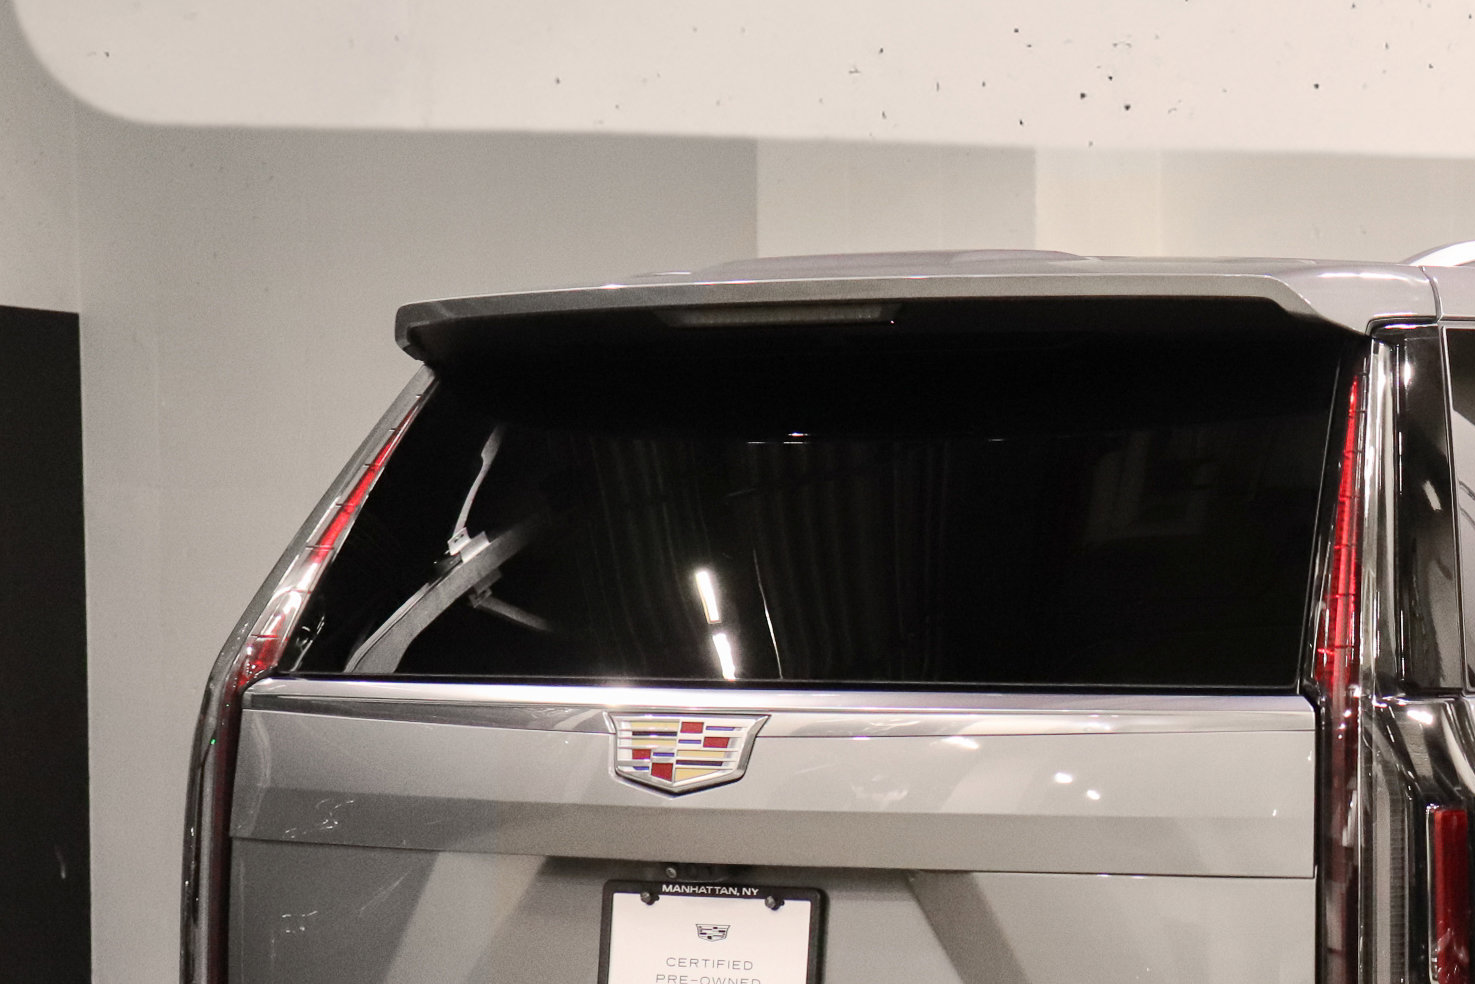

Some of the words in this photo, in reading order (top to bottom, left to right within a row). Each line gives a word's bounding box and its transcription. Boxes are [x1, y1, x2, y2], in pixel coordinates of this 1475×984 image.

[661, 884, 740, 896] MANHATTAN,
[742, 887, 760, 896] NY
[666, 957, 753, 971] CERTIFIED
